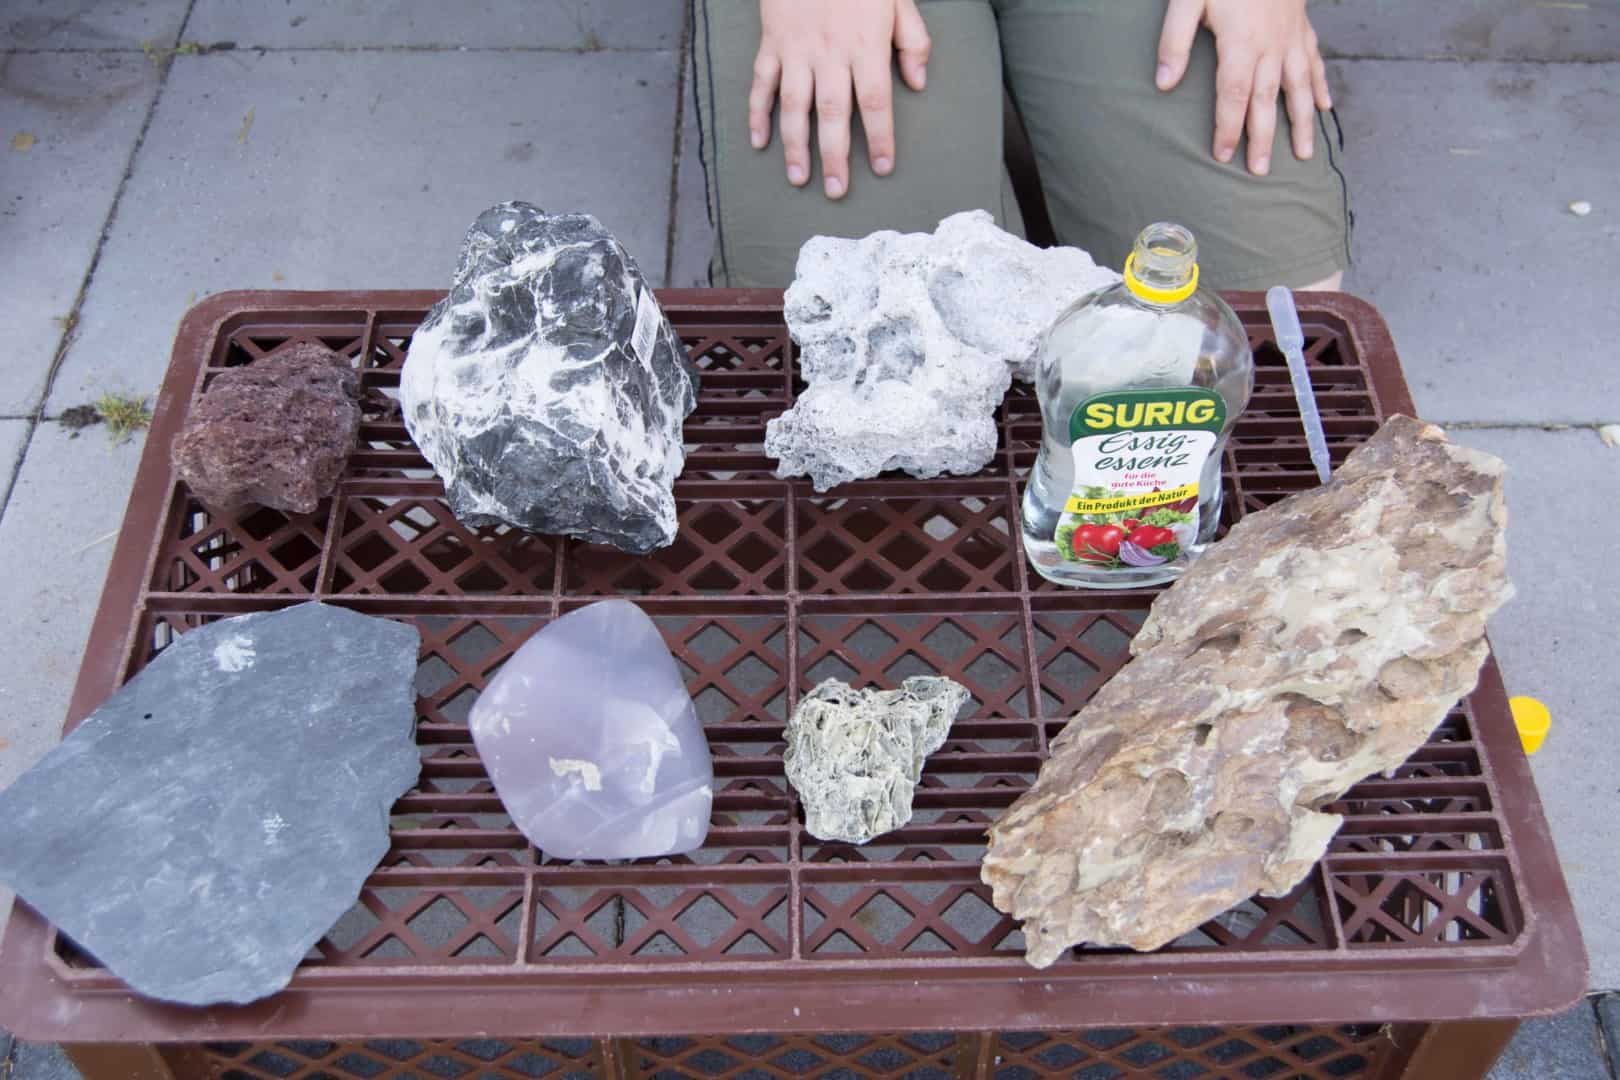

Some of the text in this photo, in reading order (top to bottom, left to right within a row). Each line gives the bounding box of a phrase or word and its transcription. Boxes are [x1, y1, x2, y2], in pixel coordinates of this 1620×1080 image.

[1084, 399, 1216, 429] SURIG
[1099, 430, 1198, 453] Essig-
[1094, 453, 1190, 470] essenz
[1111, 479, 1167, 489] gute Küche
[1140, 472, 1156, 480] die
[1077, 488, 1188, 511] Ein Produkt der Natur
